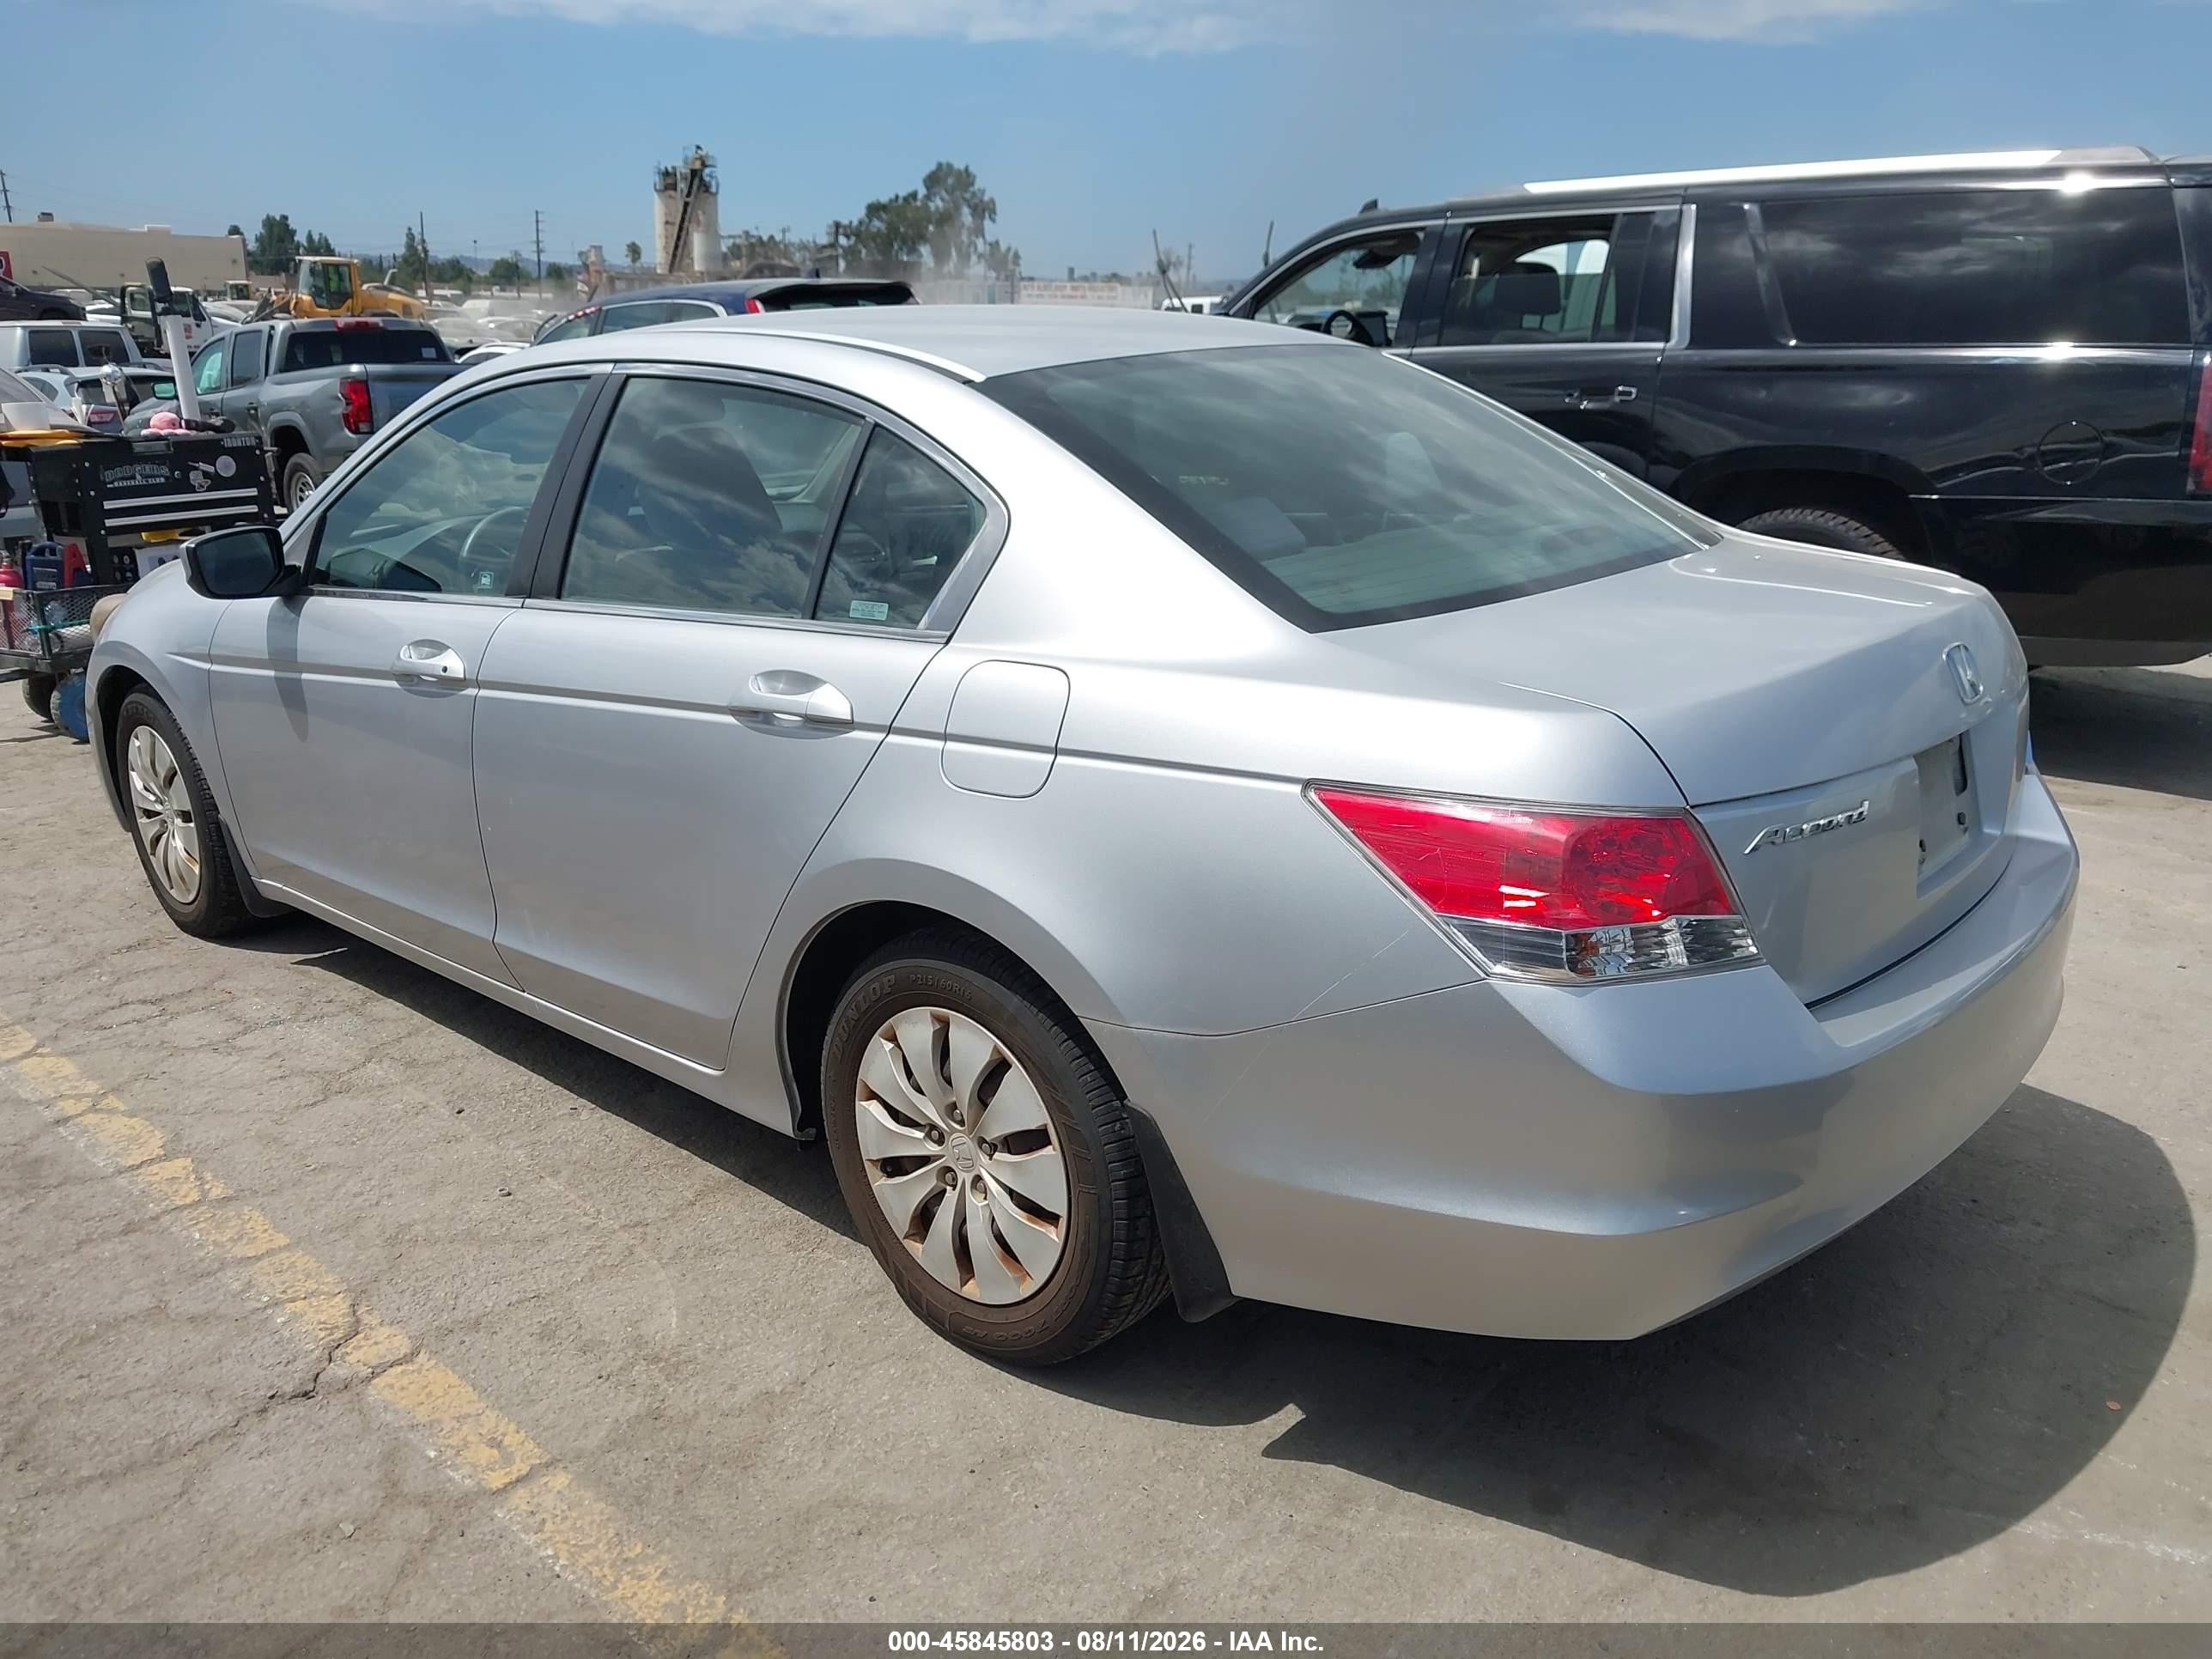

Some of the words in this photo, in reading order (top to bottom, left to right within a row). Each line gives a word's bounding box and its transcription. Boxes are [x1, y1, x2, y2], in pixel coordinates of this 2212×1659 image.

[223, 436, 256, 447] IRONTON
[105, 464, 171, 482] DODGERS
[1743, 799, 1869, 855] Accord
[831, 974, 896, 1060] DUNLOP
